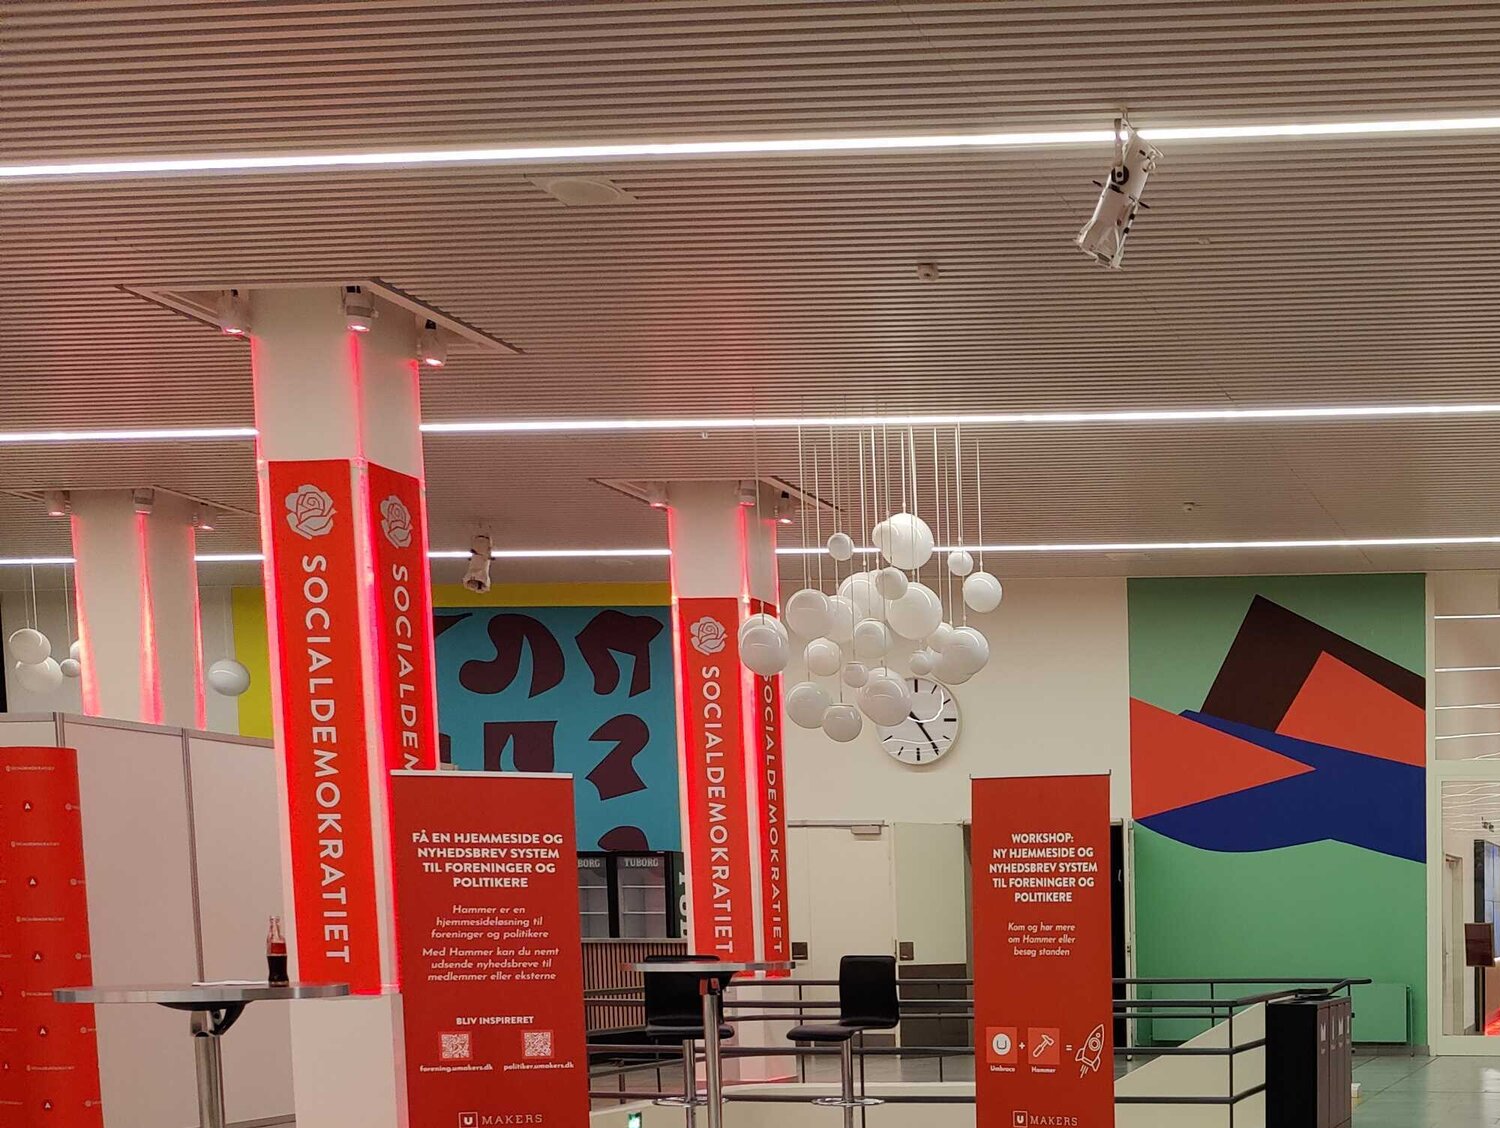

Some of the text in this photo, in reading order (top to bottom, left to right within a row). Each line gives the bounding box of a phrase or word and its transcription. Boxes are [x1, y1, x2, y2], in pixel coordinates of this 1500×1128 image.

[392, 564, 420, 770] SOCIALDEM
[302, 554, 350, 963] SOCIALDEMOKRATIET
[702, 666, 734, 953] SOCIALDEMOKRATIET
[412, 829, 564, 844] FÅ EN HJEMMESIDE OG
[1011, 833, 1074, 844] WORKSHOP:
[417, 847, 560, 859] NYHEDSBREV SYSTEM
[992, 847, 1094, 859] NY HJEMMESIDE OG
[422, 862, 556, 873] TIL FORENINGER OG
[577, 858, 601, 868] BORG
[624, 857, 659, 867] TUBORG
[989, 862, 1098, 873] NYHEDSBREV SYSTEM
[453, 877, 529, 888] POLITIKERE
[992, 877, 1094, 888] TIL FORENINGER OG
[1014, 892, 1073, 903] POLITIKERE
[452, 905, 497, 914] Hammer
[533, 917, 543, 926] til
[1008, 922, 1026, 931] Kom
[1027, 924, 1038, 933] og
[431, 929, 549, 940] foreninger og politikere
[1008, 934, 1076, 944] om Hammer eller
[422, 947, 559, 956] Med Hammer kan du nemt
[1039, 947, 1070, 956] standen
[431, 959, 552, 970] udsende nyhedsbreve til
[428, 971, 556, 981] medlemmer eller eksterne
[456, 1016, 534, 1025] BLIV INSPIRERET
[481, 1114, 543, 1125] MAKERS
[1029, 1115, 1078, 1126] MAKERS
